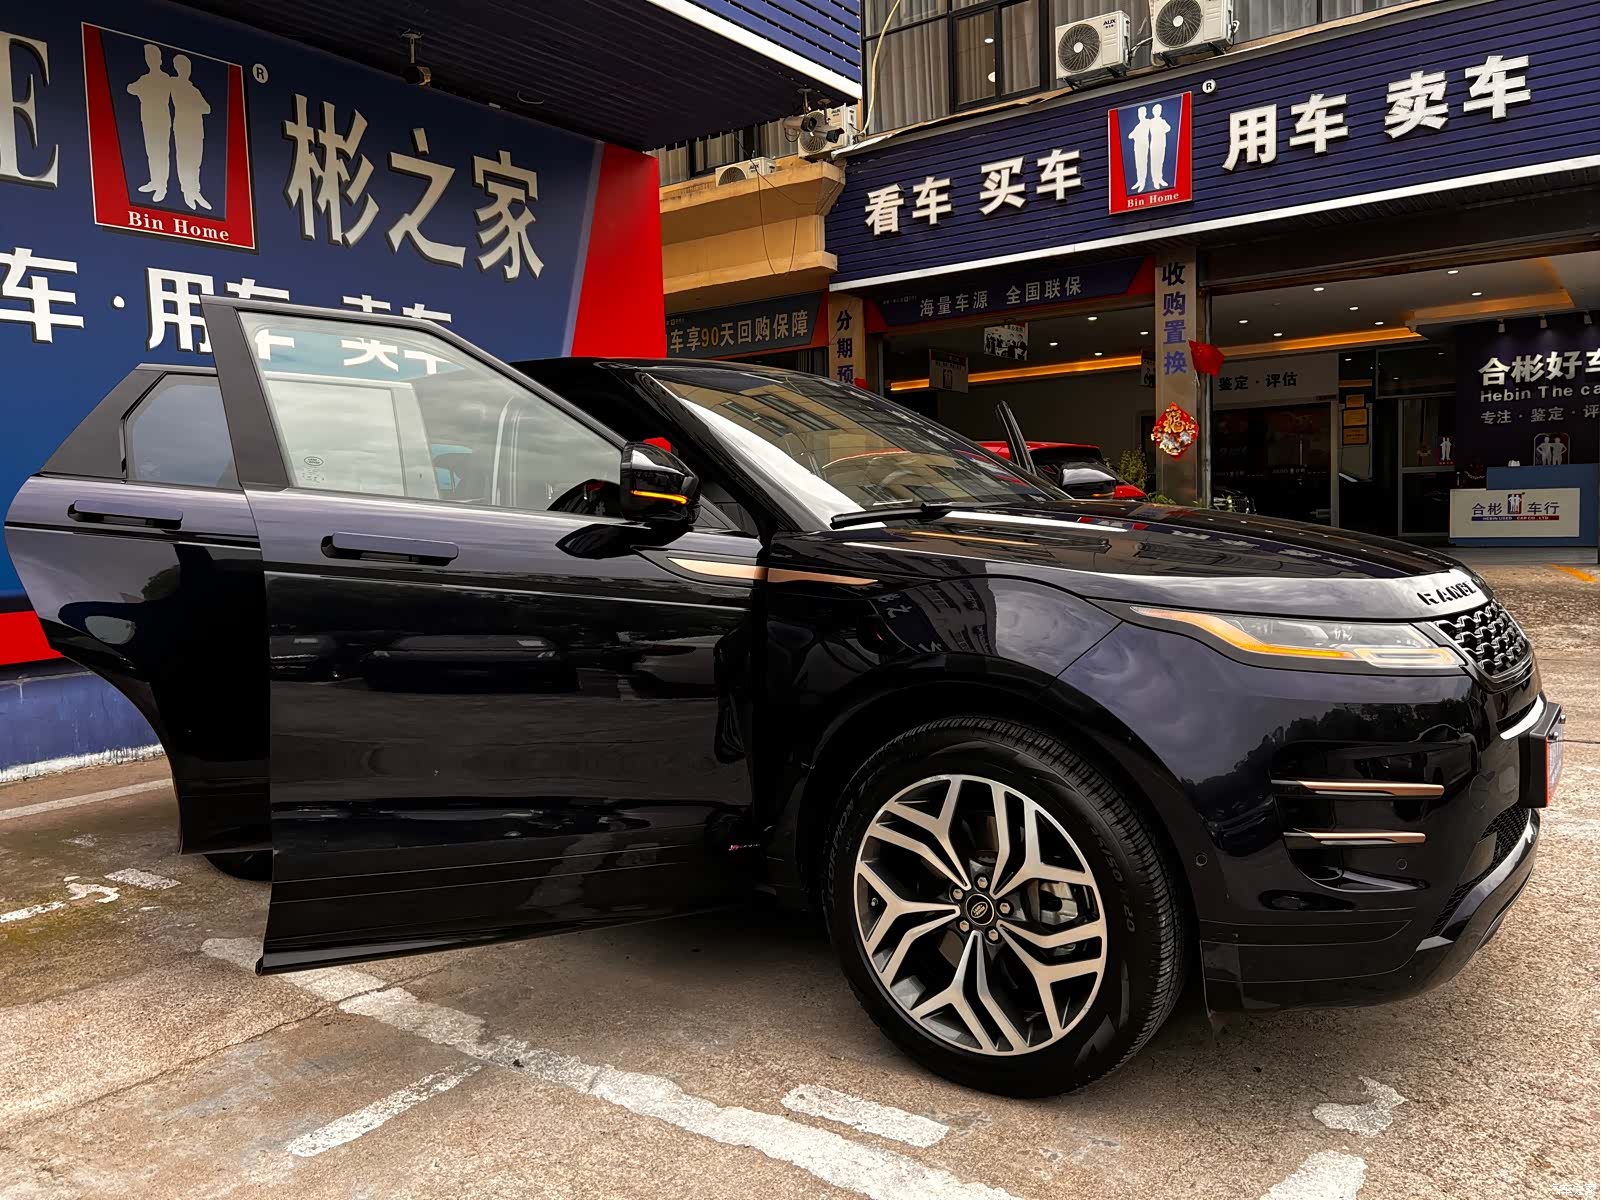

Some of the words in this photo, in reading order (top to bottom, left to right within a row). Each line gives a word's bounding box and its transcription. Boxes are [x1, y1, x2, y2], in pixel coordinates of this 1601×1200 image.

[283, 93, 545, 280] 彬之家
[1127, 198, 1144, 208] Bin
[1149, 192, 1179, 204] Home
[128, 210, 164, 231] Bin
[173, 217, 230, 241] Home
[919, 290, 989, 317] 海量车源
[1006, 275, 1083, 305] 全国联保
[670, 309, 809, 354] 车享90天回购保障
[1162, 261, 1188, 376] 收购置换
[836, 310, 854, 385] 分期预
[1480, 388, 1531, 402] Hebin
[1538, 386, 1574, 398] The
[1471, 502, 1503, 516] 合彬
[1527, 501, 1560, 515] 车行
